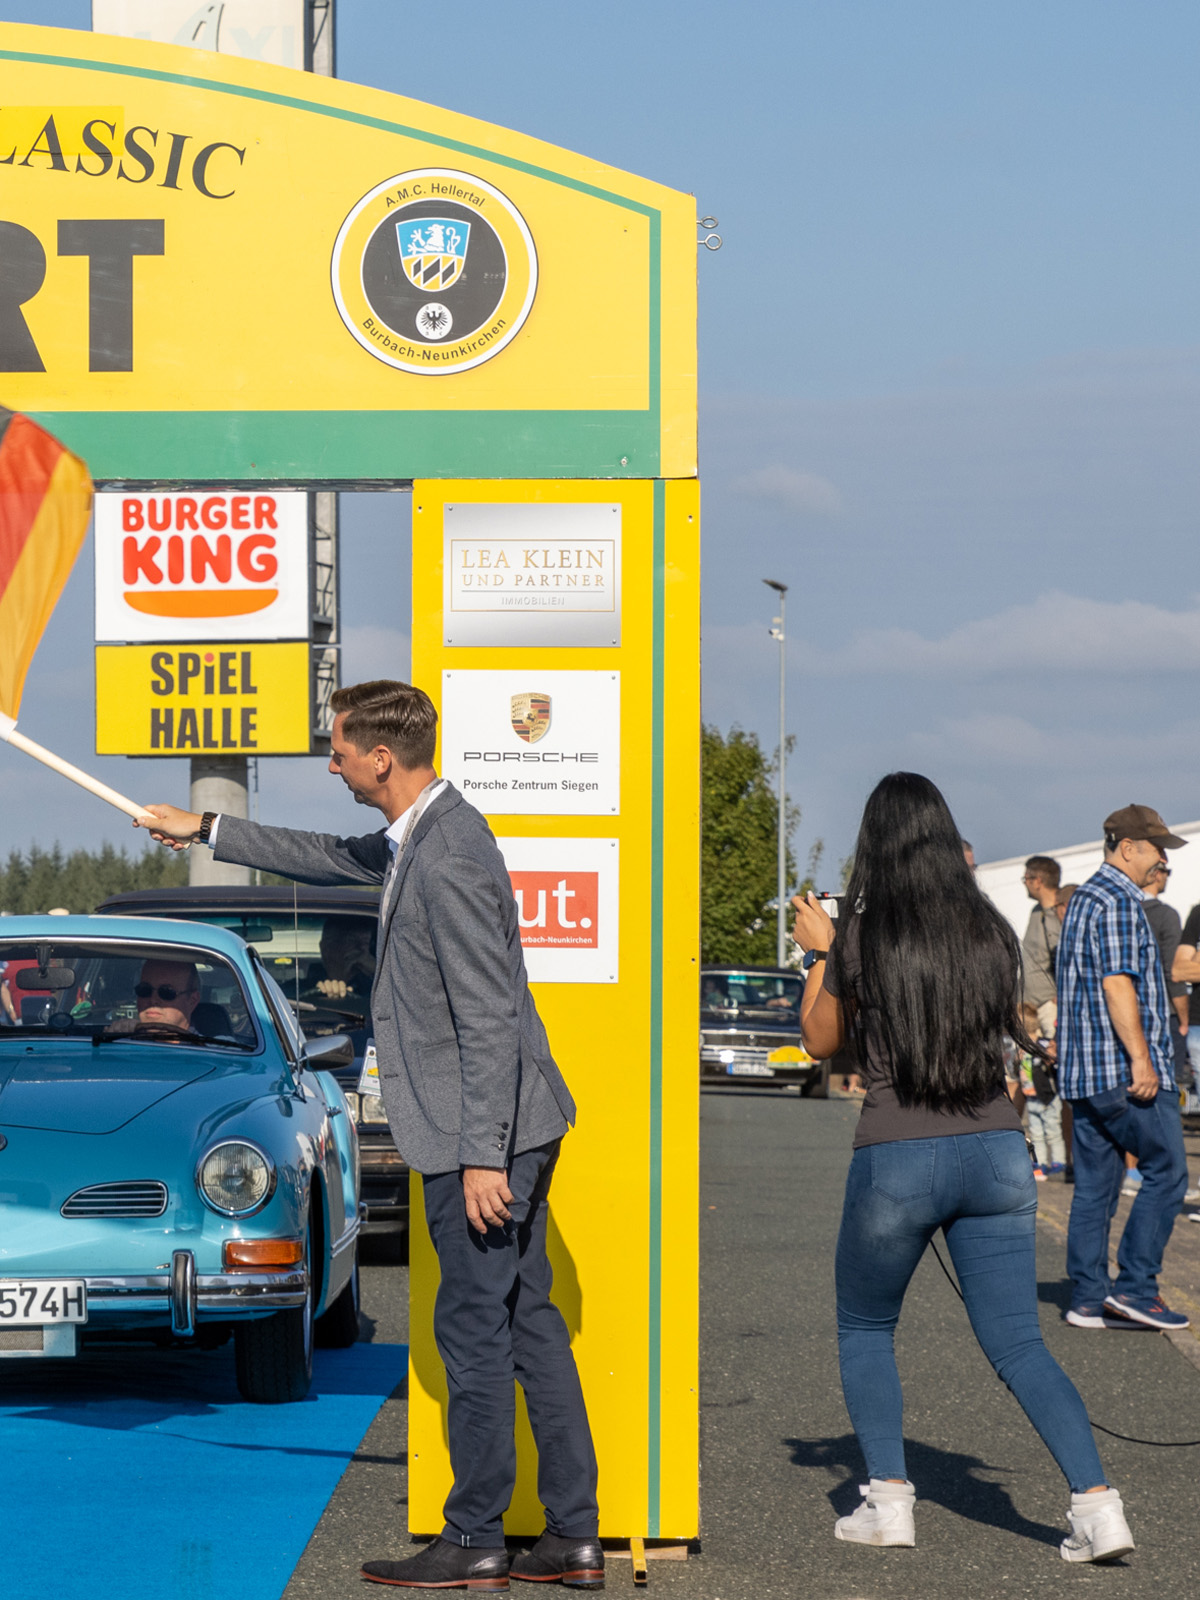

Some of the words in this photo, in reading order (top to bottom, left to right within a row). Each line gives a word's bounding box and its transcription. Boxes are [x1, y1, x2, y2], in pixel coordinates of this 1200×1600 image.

[384, 184, 426, 208] A.M.C.
[431, 183, 485, 208] Hellertal
[362, 317, 507, 361] Burbach-Neunkirchen
[122, 496, 278, 532] BURGER
[123, 534, 278, 585] KING
[461, 549, 510, 568] LEA
[522, 549, 604, 568] KLEIN
[462, 574, 504, 587] UND
[514, 574, 605, 587] PARTNER
[501, 596, 564, 606] IMMOBILIEN
[151, 708, 257, 749] HALLE
[464, 752, 598, 763] PORSCHE
[463, 780, 507, 791] Porsche
[511, 780, 557, 791] Zentrum
[561, 780, 599, 793] Siegen
[515, 879, 592, 928] ut.
[521, 936, 592, 944] urbach-Neunkirchen
